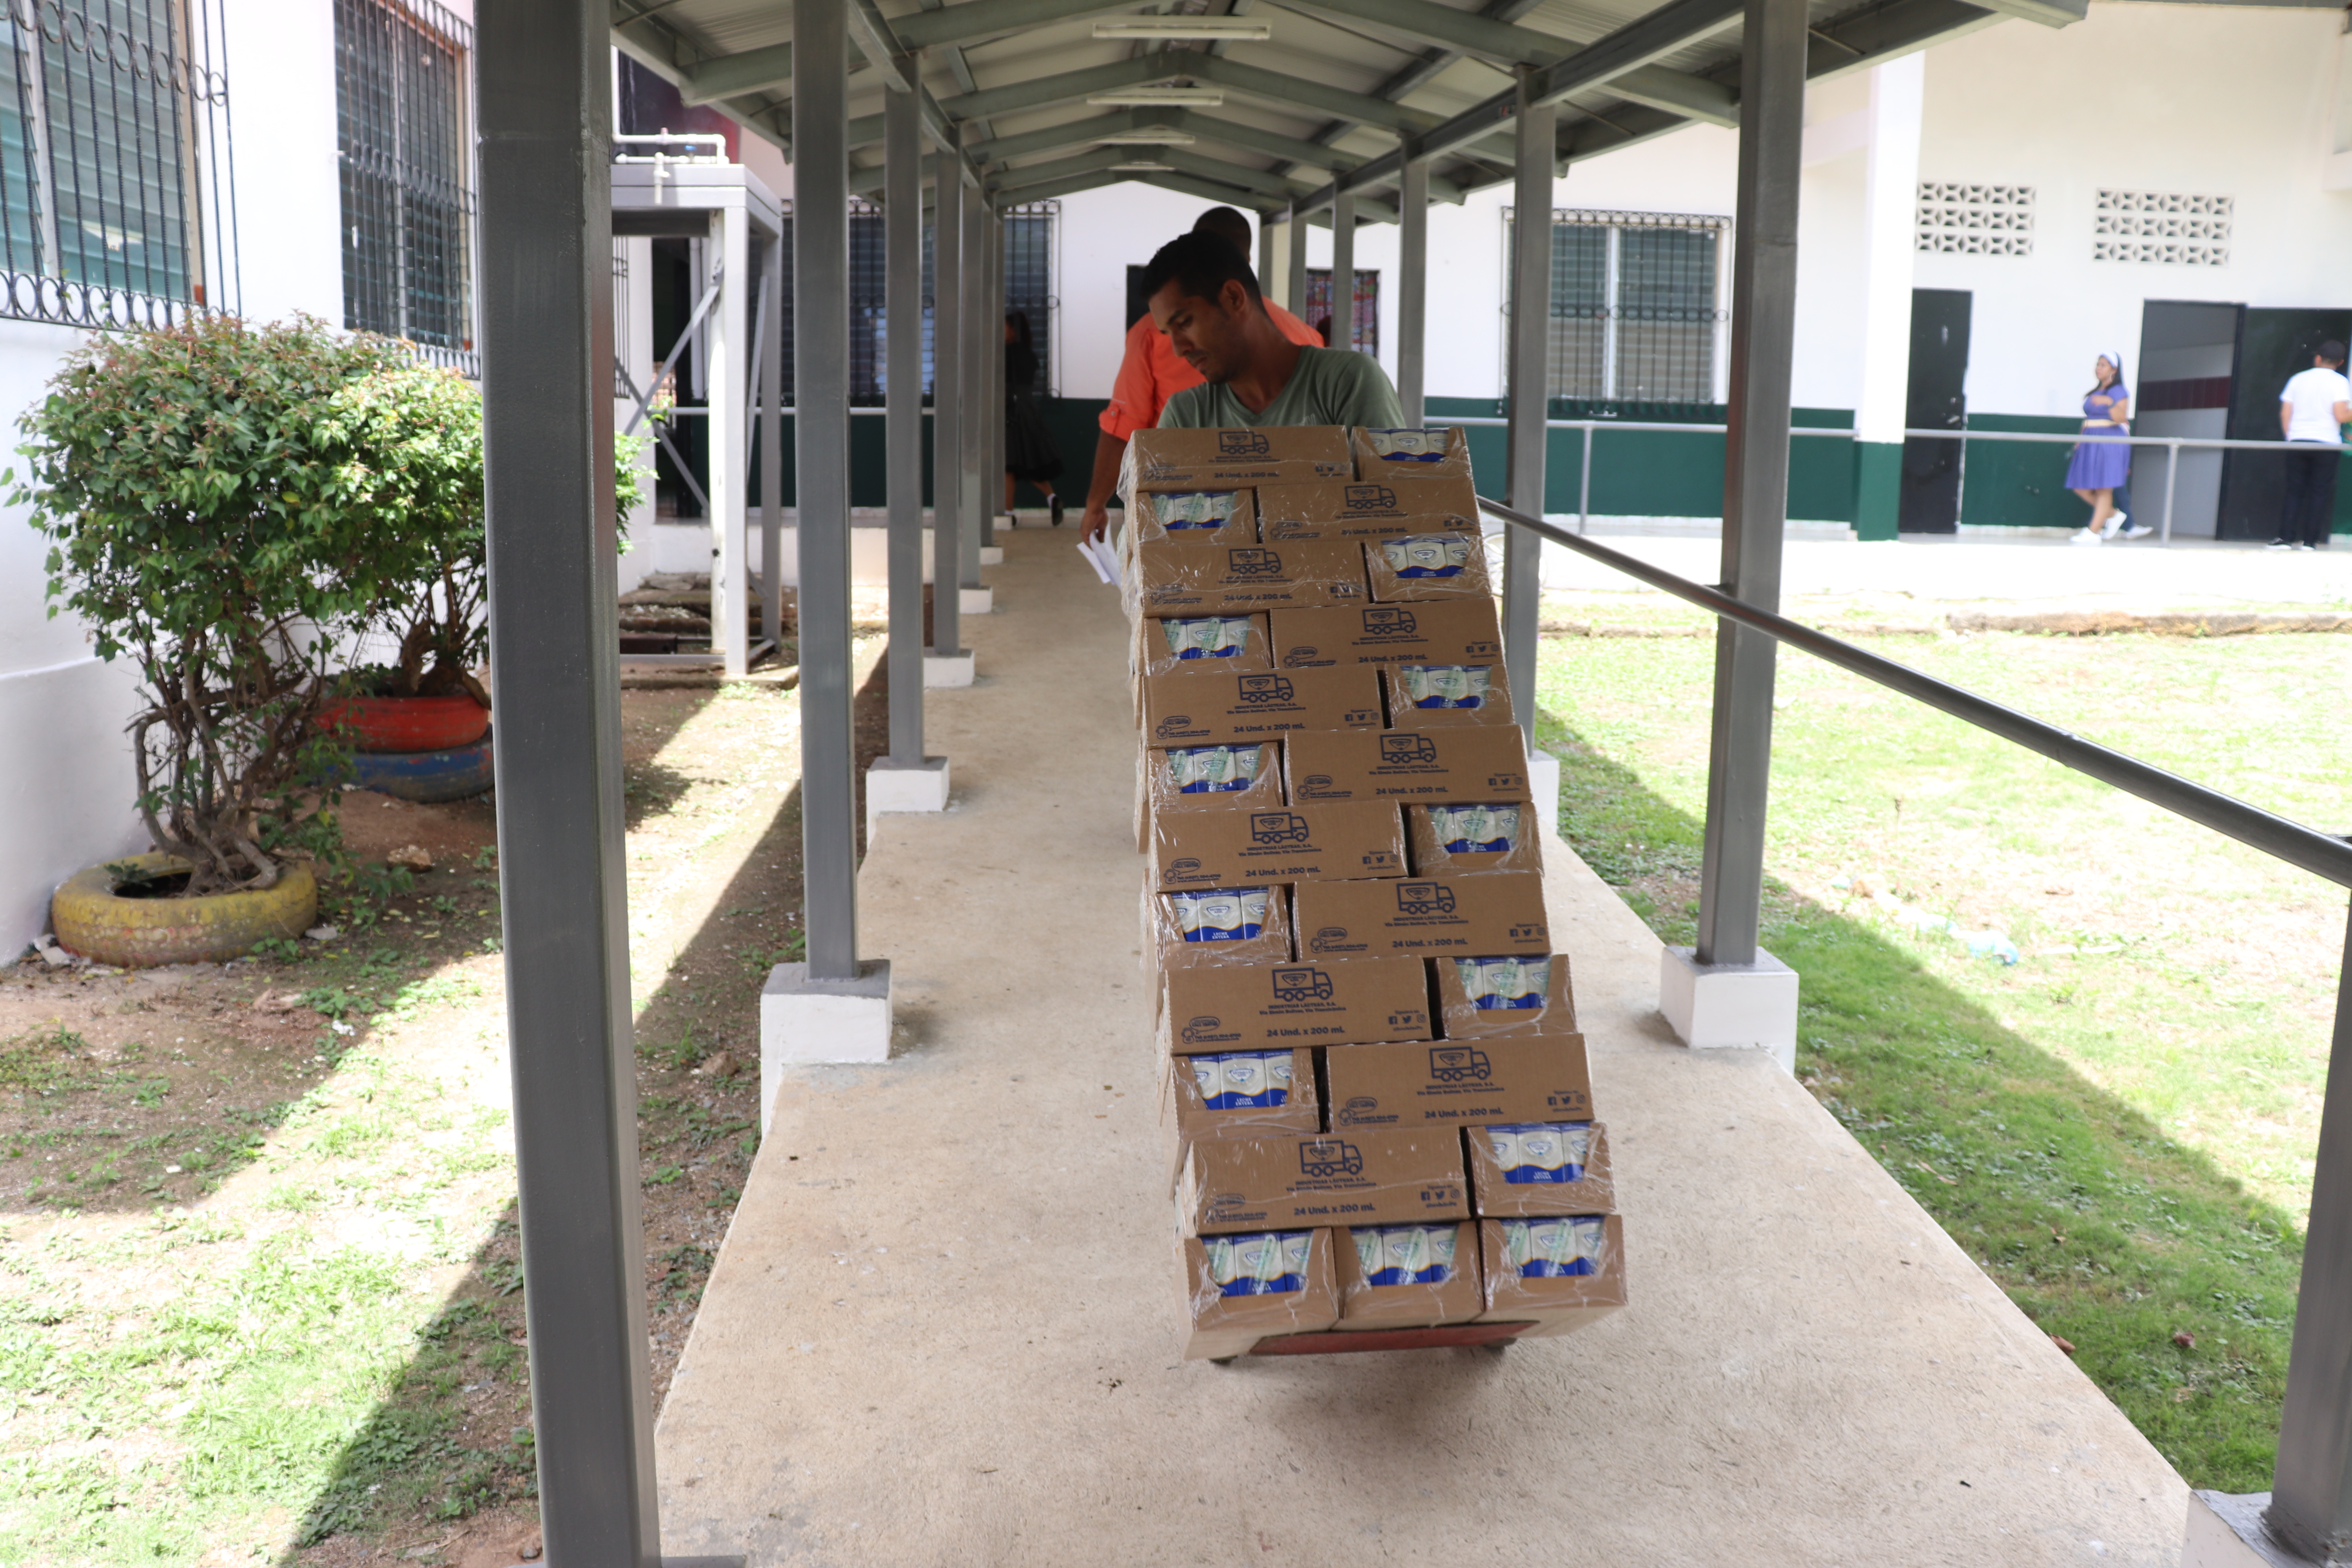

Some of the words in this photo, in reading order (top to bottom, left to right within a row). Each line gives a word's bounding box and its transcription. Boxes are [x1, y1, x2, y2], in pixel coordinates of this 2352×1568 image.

[1258, 868, 1279, 876] Und.
[1267, 1029, 1278, 1037] 24
[1280, 1028, 1301, 1036] Und.
[1310, 1026, 1329, 1034] 200
[1425, 1111, 1436, 1119] 24
[1438, 1109, 1459, 1118] Und.
[1468, 1107, 1487, 1116] 200
[1294, 1207, 1306, 1216] 24
[1339, 1203, 1359, 1212] 200
